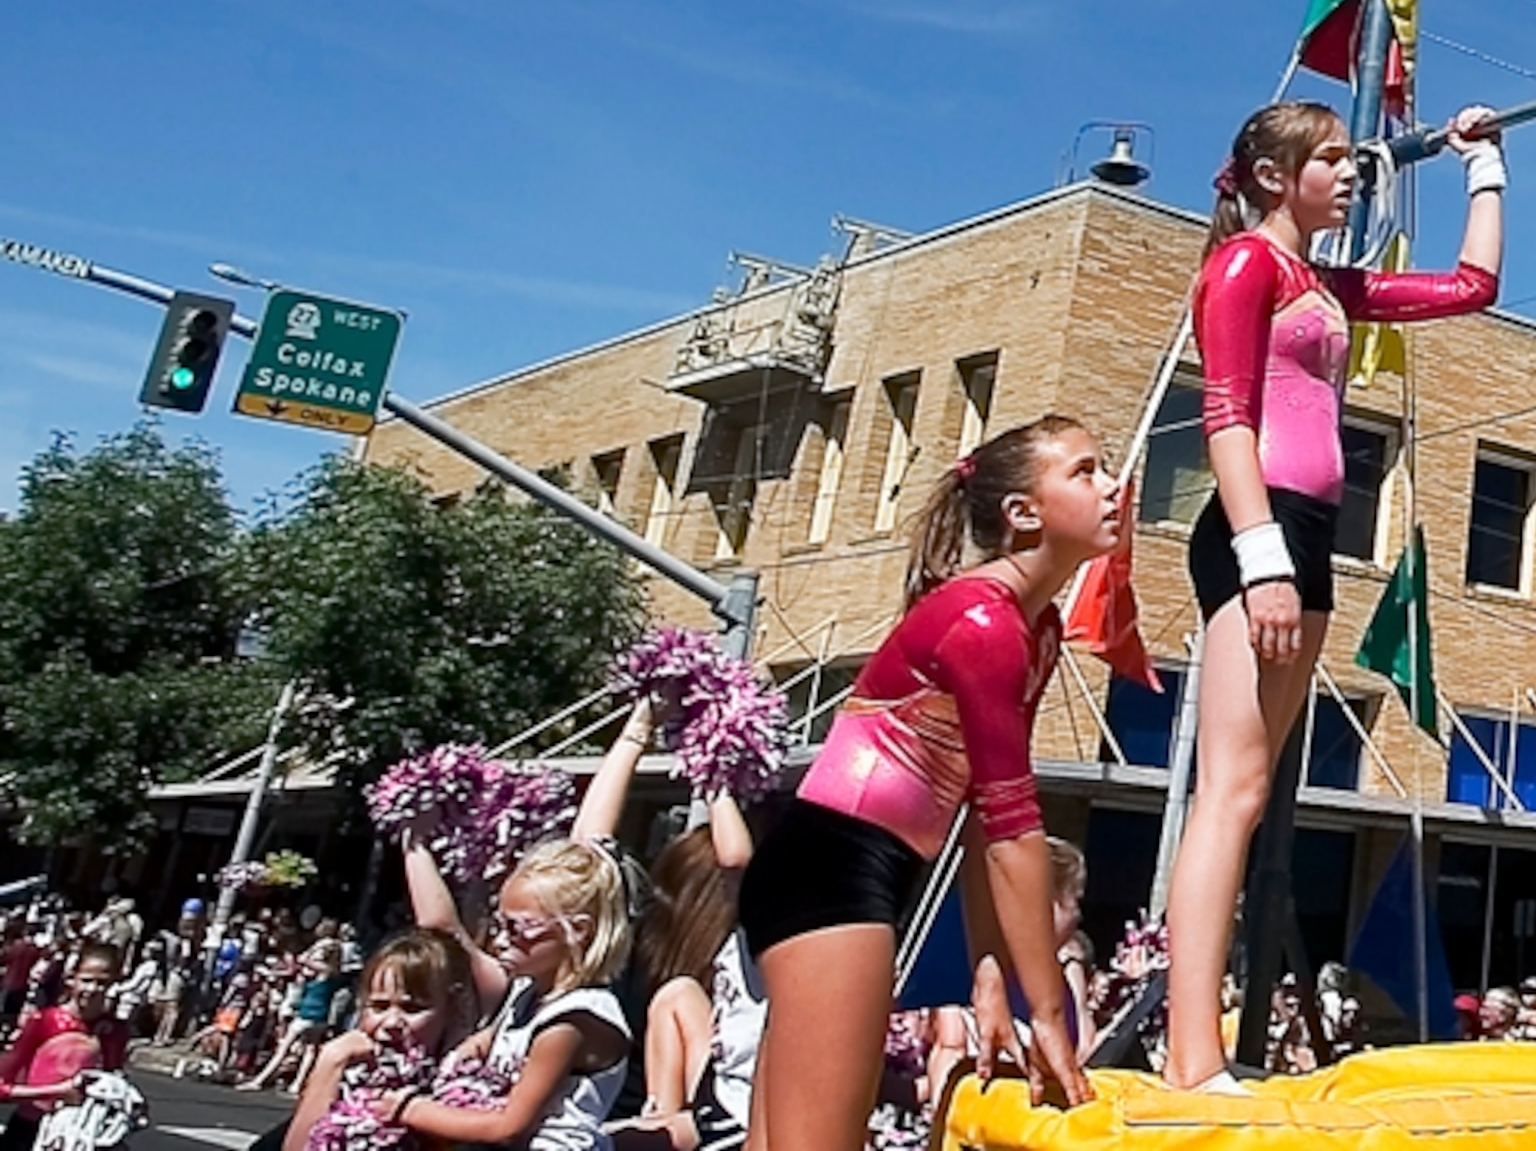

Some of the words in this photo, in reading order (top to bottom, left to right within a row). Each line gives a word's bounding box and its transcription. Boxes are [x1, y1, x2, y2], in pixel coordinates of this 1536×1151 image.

[333, 309, 382, 331] WEST
[277, 342, 366, 378] Colfax
[253, 366, 372, 408] Spokane
[300, 407, 350, 426] ONLY
